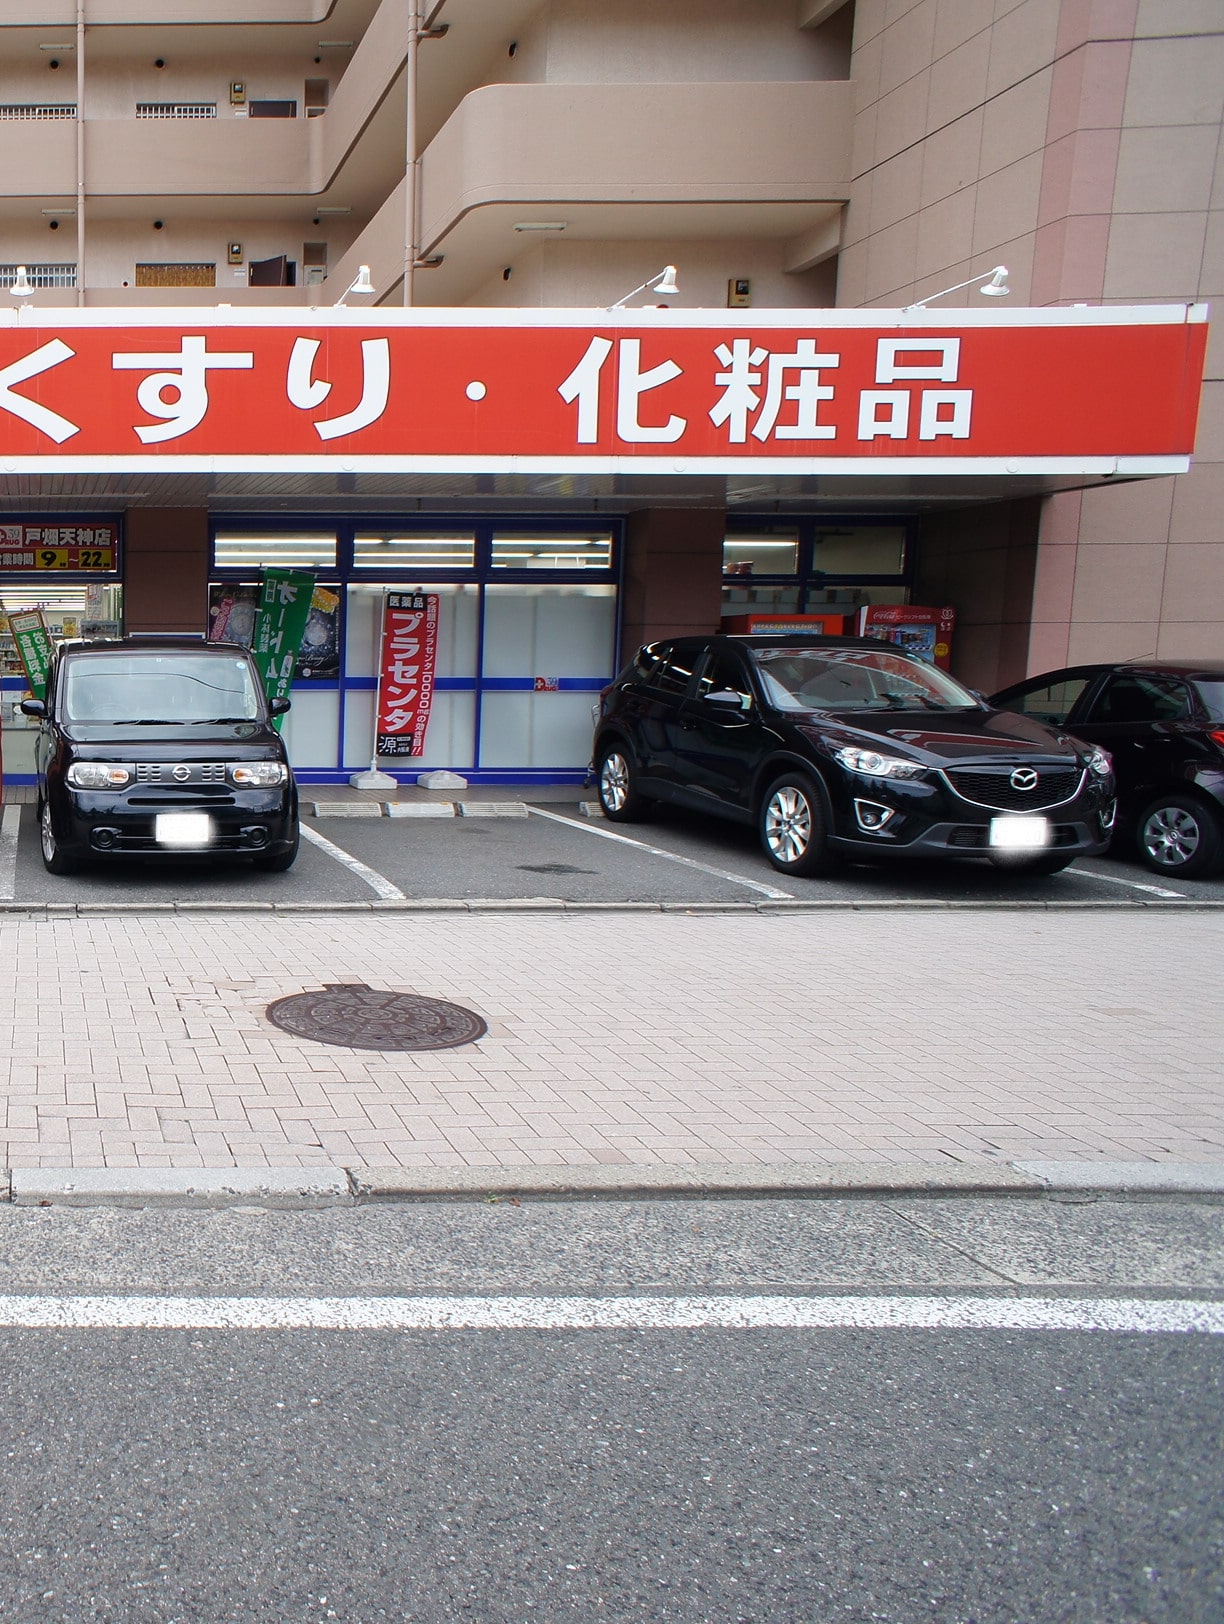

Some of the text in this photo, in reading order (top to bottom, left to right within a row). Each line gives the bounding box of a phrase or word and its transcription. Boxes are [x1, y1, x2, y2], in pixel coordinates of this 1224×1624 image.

[25, 528, 112, 546] 戸畑天神店
[389, 595, 424, 608] 医薬品
[384, 612, 425, 732] プラセンタ
[378, 735, 397, 754] 源
